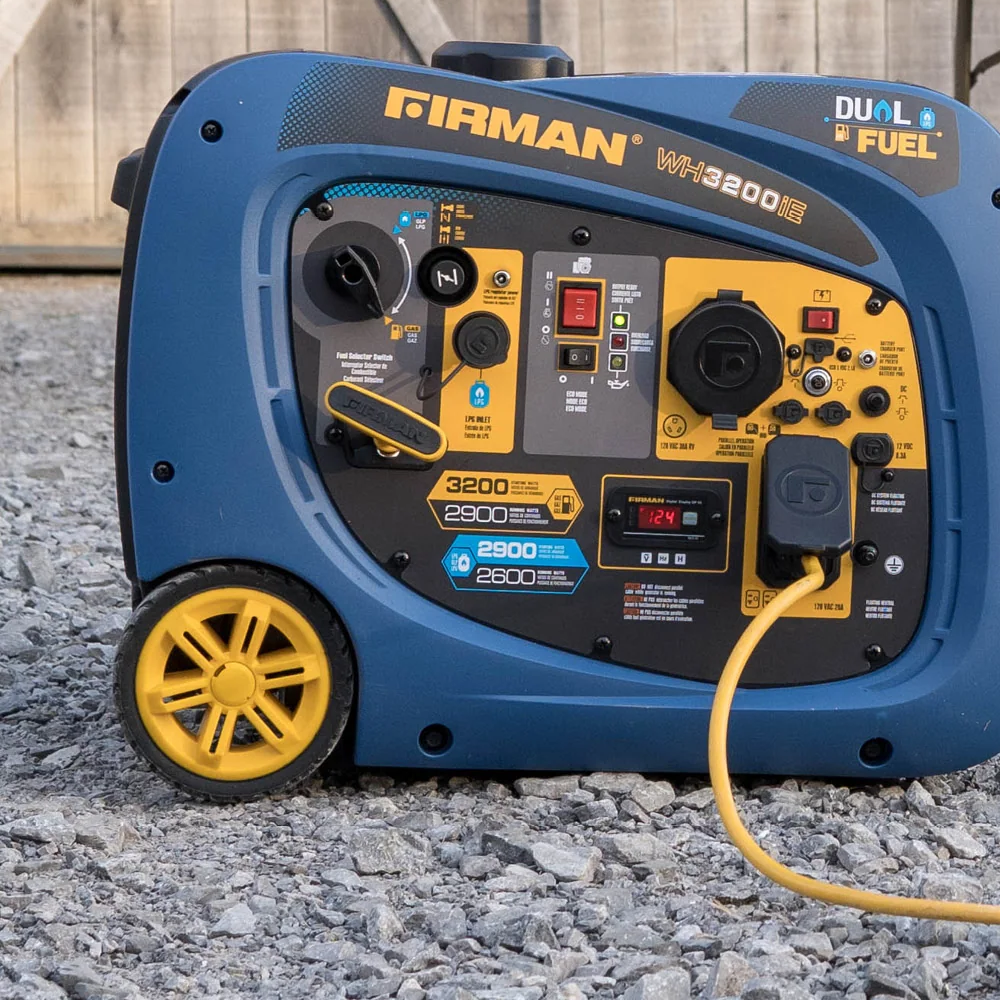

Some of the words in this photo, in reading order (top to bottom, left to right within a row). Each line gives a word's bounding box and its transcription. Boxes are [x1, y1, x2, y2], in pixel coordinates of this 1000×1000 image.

[835, 95, 912, 126] DUAL
[384, 86, 628, 167] FIRMAN
[857, 128, 938, 160] FUEL
[336, 351, 348, 359] Fuel
[348, 352, 373, 360] Selector
[373, 353, 393, 361] Switch
[446, 476, 509, 496] 3200
[628, 496, 665, 504] FIRMAN
[444, 504, 508, 524] 2900
[648, 509, 676, 524] 124
[477, 540, 538, 559] 2900
[476, 567, 536, 585] 2600
